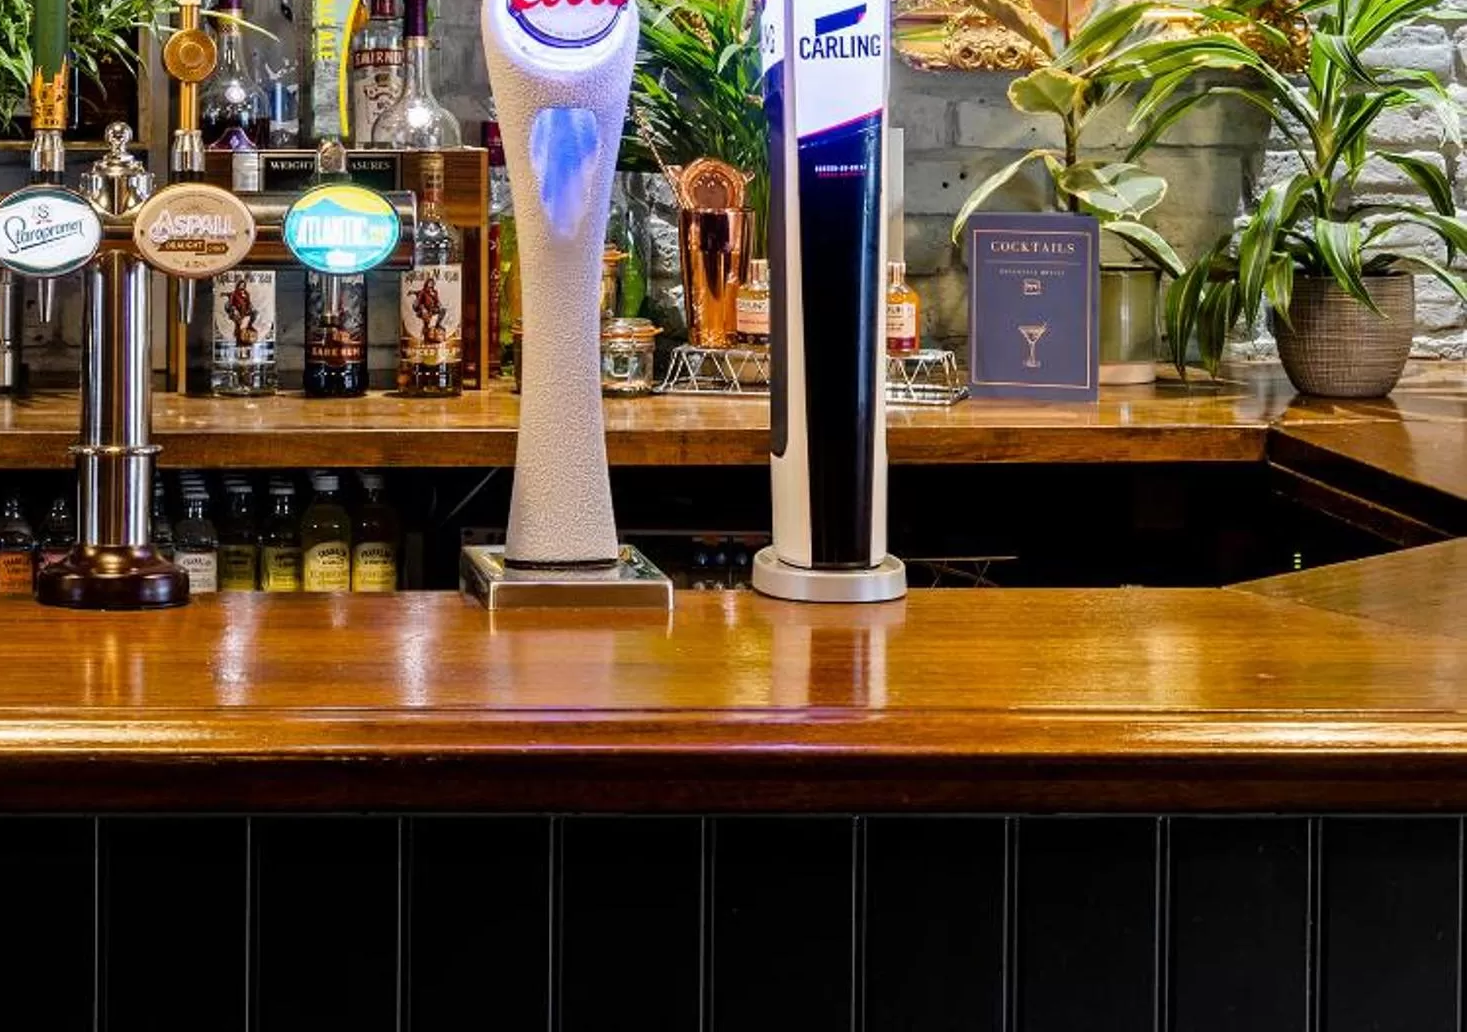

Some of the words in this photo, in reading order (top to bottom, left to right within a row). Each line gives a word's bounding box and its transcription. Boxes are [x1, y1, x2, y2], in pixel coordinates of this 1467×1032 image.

[799, 34, 882, 60] CARLING
[354, 50, 404, 64] SMIRNO
[270, 160, 315, 171] WEIGHT
[990, 240, 1076, 255] COCKTAILS
